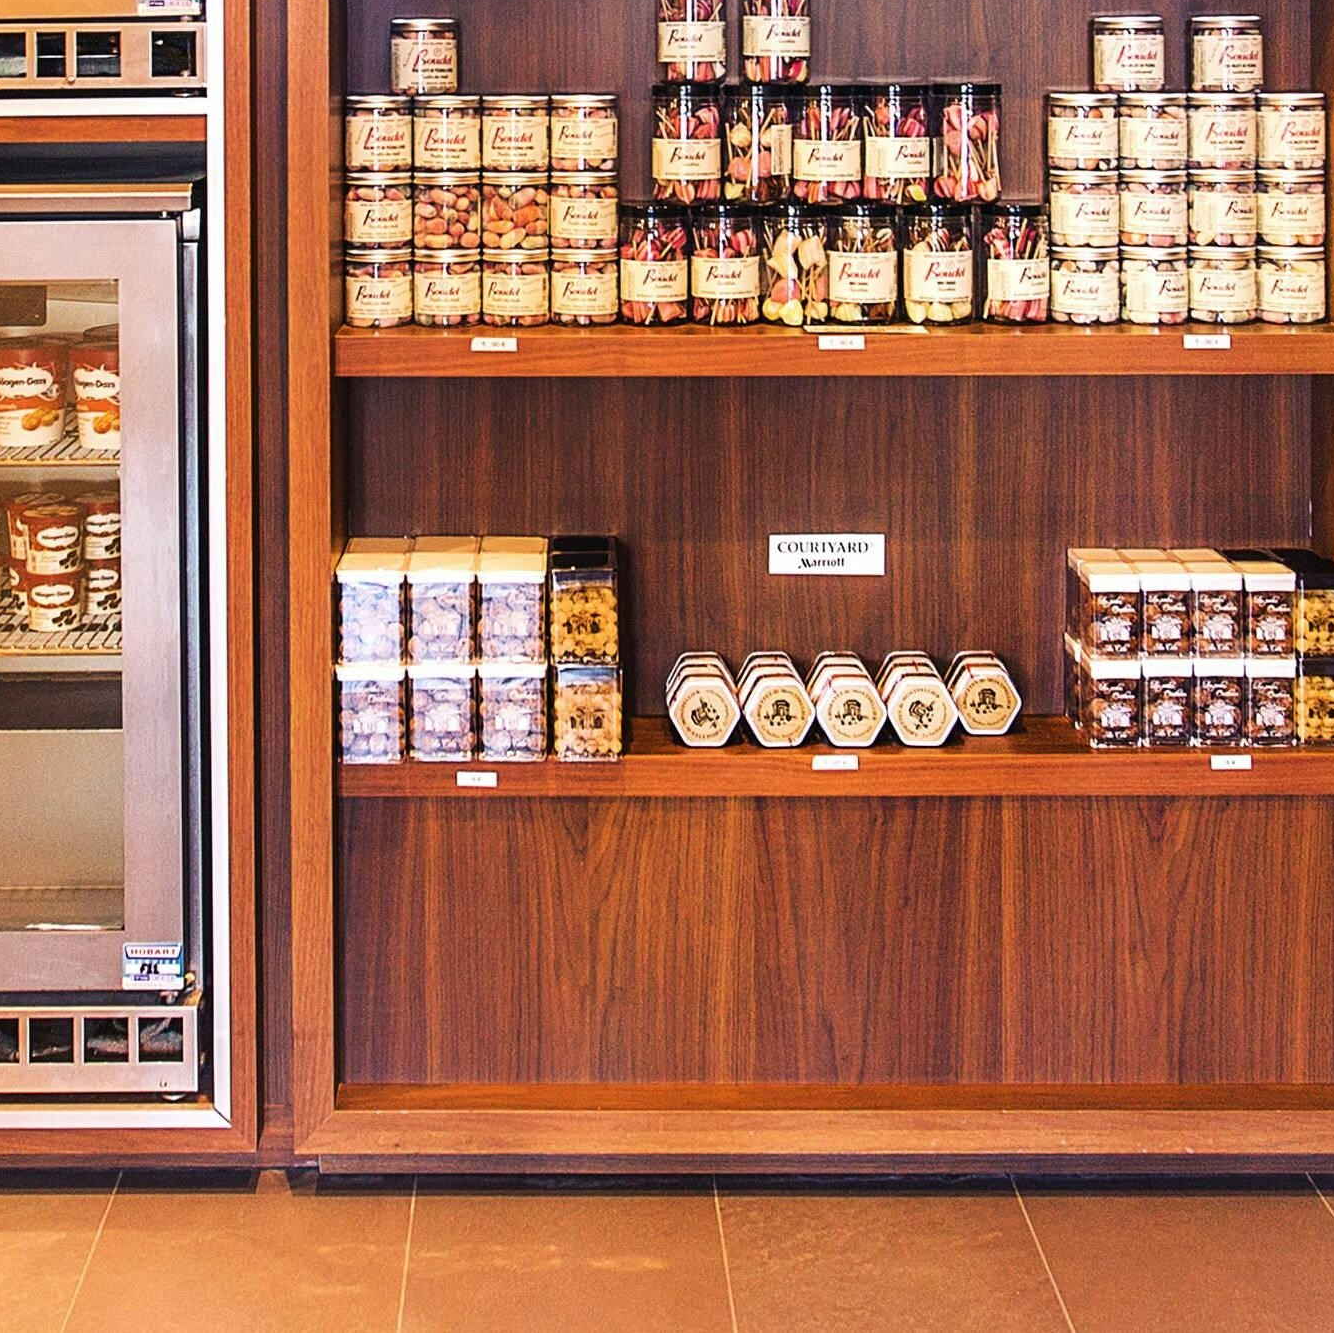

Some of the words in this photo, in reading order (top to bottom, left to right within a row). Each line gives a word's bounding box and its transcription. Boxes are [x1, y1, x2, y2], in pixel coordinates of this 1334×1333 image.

[777, 540, 869, 554] COURTYARD
[798, 557, 845, 569] Marriott
[130, 948, 177, 956] HOBART
